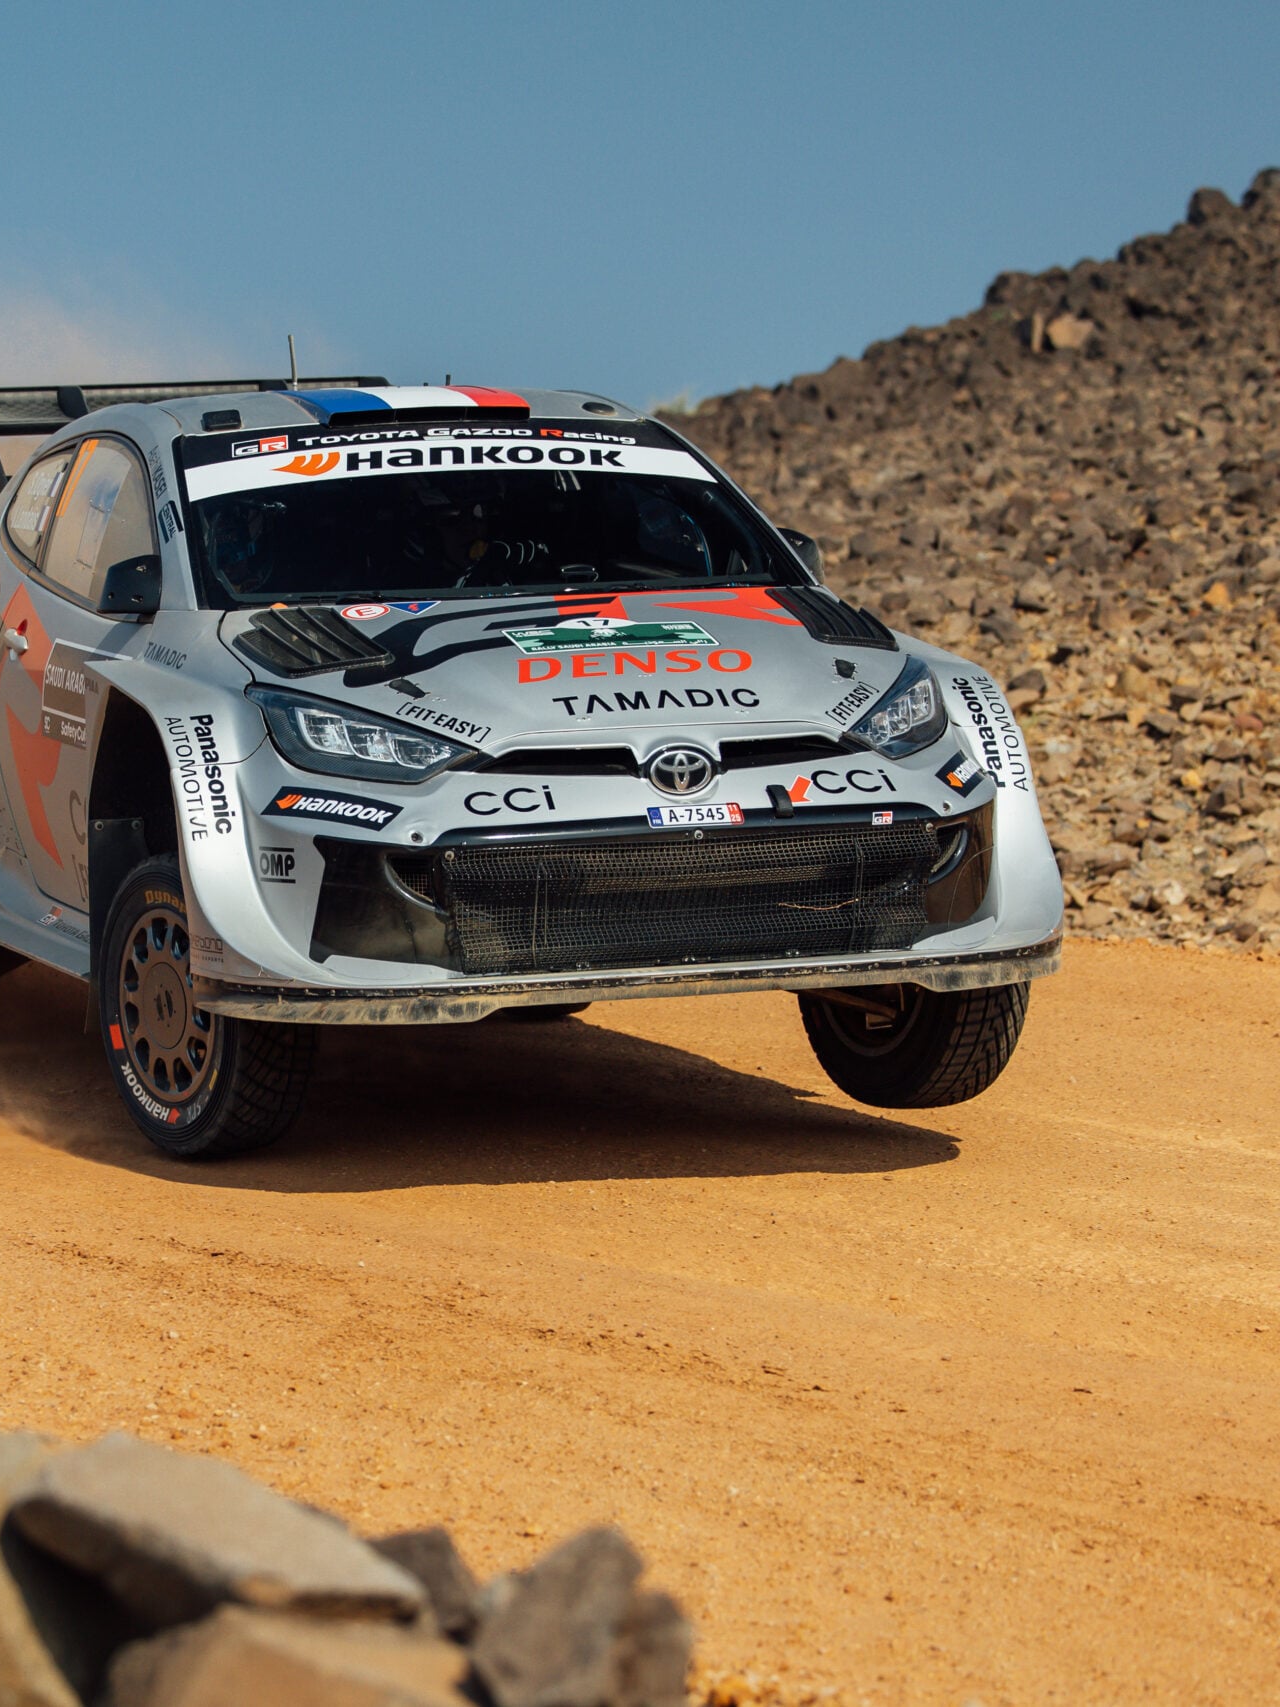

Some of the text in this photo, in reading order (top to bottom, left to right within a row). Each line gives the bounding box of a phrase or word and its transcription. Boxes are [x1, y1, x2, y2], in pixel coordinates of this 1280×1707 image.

[233, 439, 287, 457] GR
[297, 428, 636, 446] TOYOTA GAZOO Racing
[144, 641, 188, 670] TAMADIC
[517, 649, 752, 684] DENSO
[45, 664, 65, 689] SAUDI
[552, 687, 760, 716] TAMADIC
[952, 677, 1006, 788] Panasonic
[972, 674, 1029, 792] AUTOMOTIVE
[164, 717, 208, 841] AUTOMOTIVE
[189, 714, 236, 834] Panasonic
[669, 807, 725, 823] A-7545
[731, 814, 741, 822] 25
[260, 853, 295, 877] OMP
